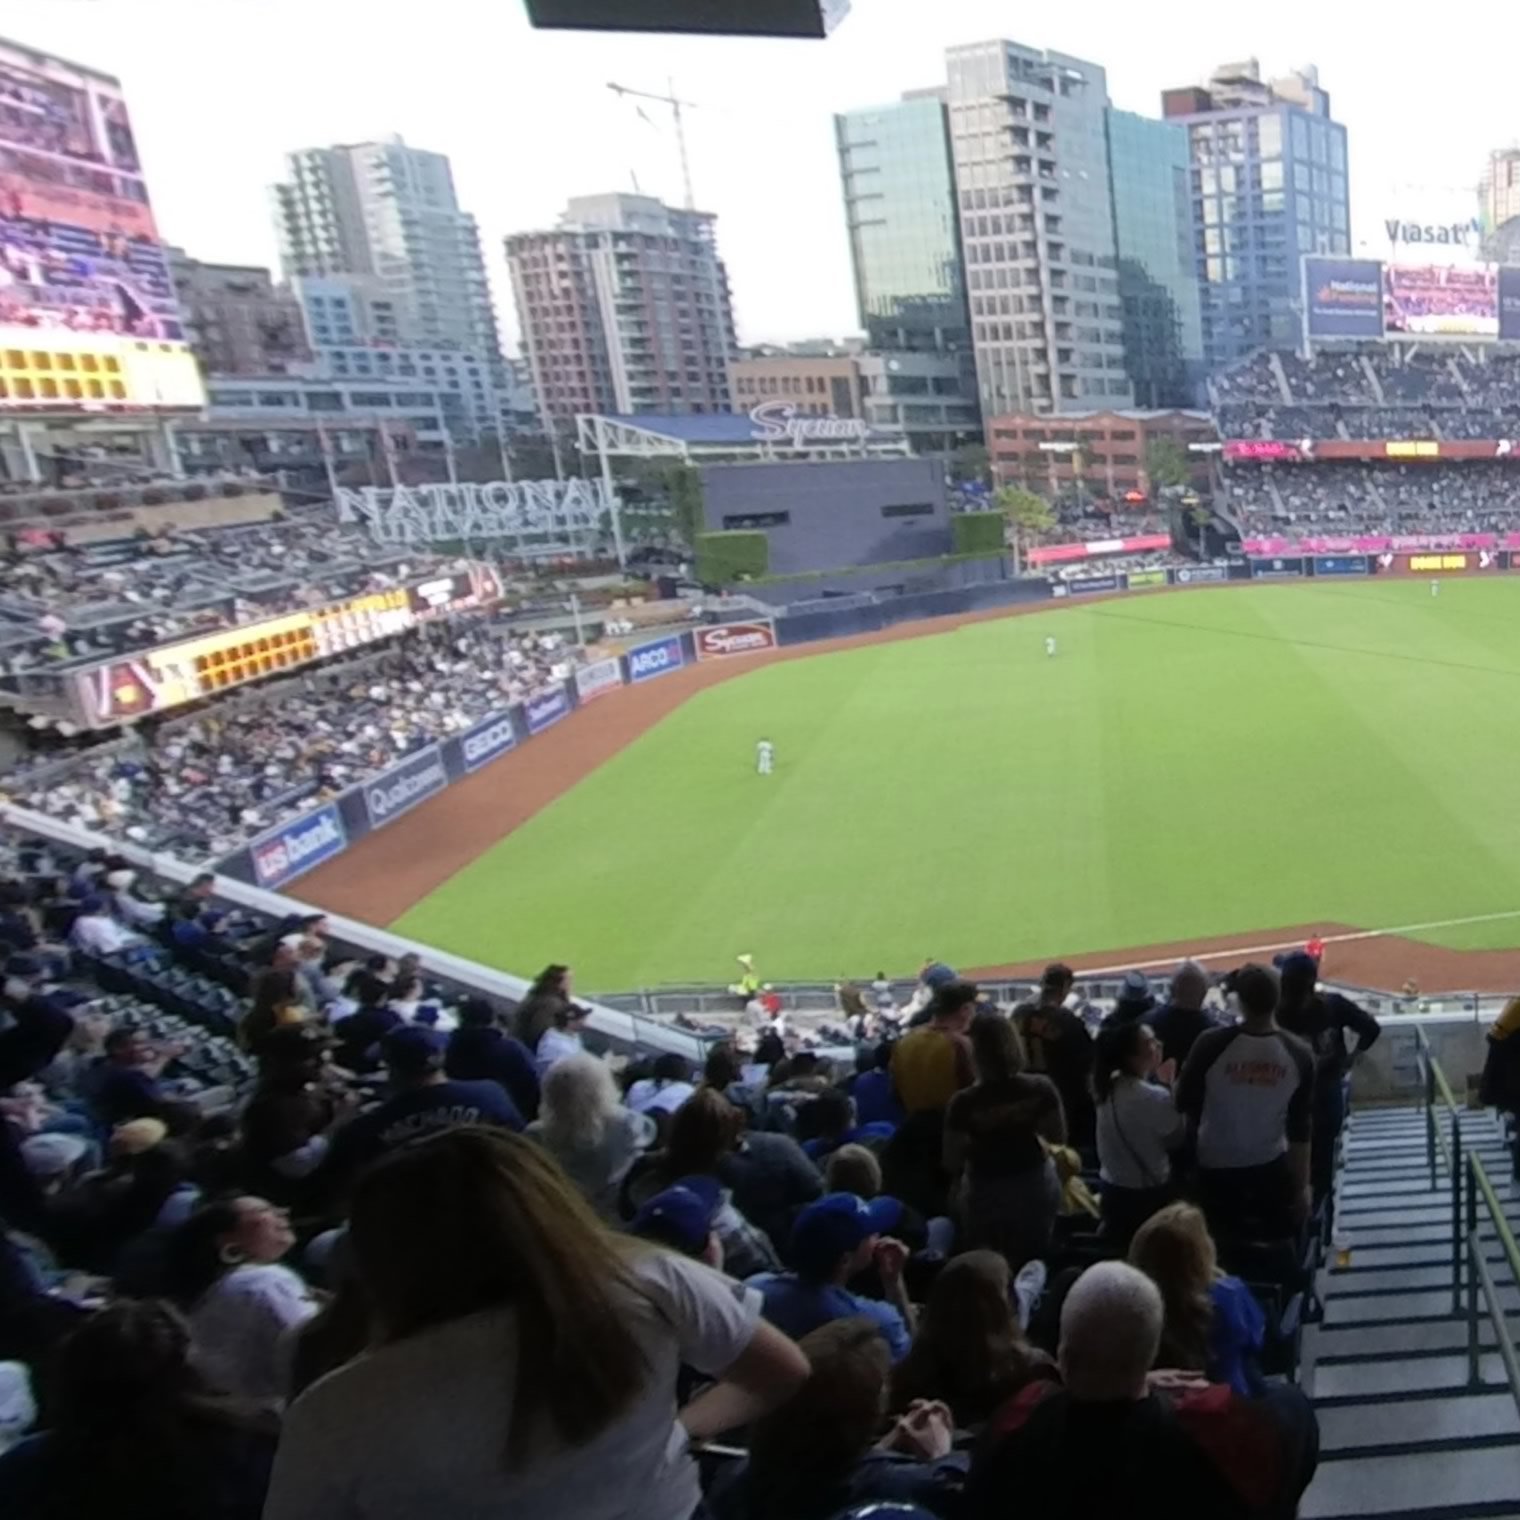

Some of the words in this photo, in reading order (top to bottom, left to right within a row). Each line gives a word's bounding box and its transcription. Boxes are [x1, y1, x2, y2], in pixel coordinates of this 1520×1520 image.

[1385, 219, 1463, 245] Viasat
[750, 401, 871, 450] Sycuan
[334, 477, 611, 522] NATIONAL
[631, 647, 668, 674] ARCO
[705, 629, 765, 652] Sycuan
[464, 719, 511, 761] GEICO
[370, 764, 444, 815] Qualcomm
